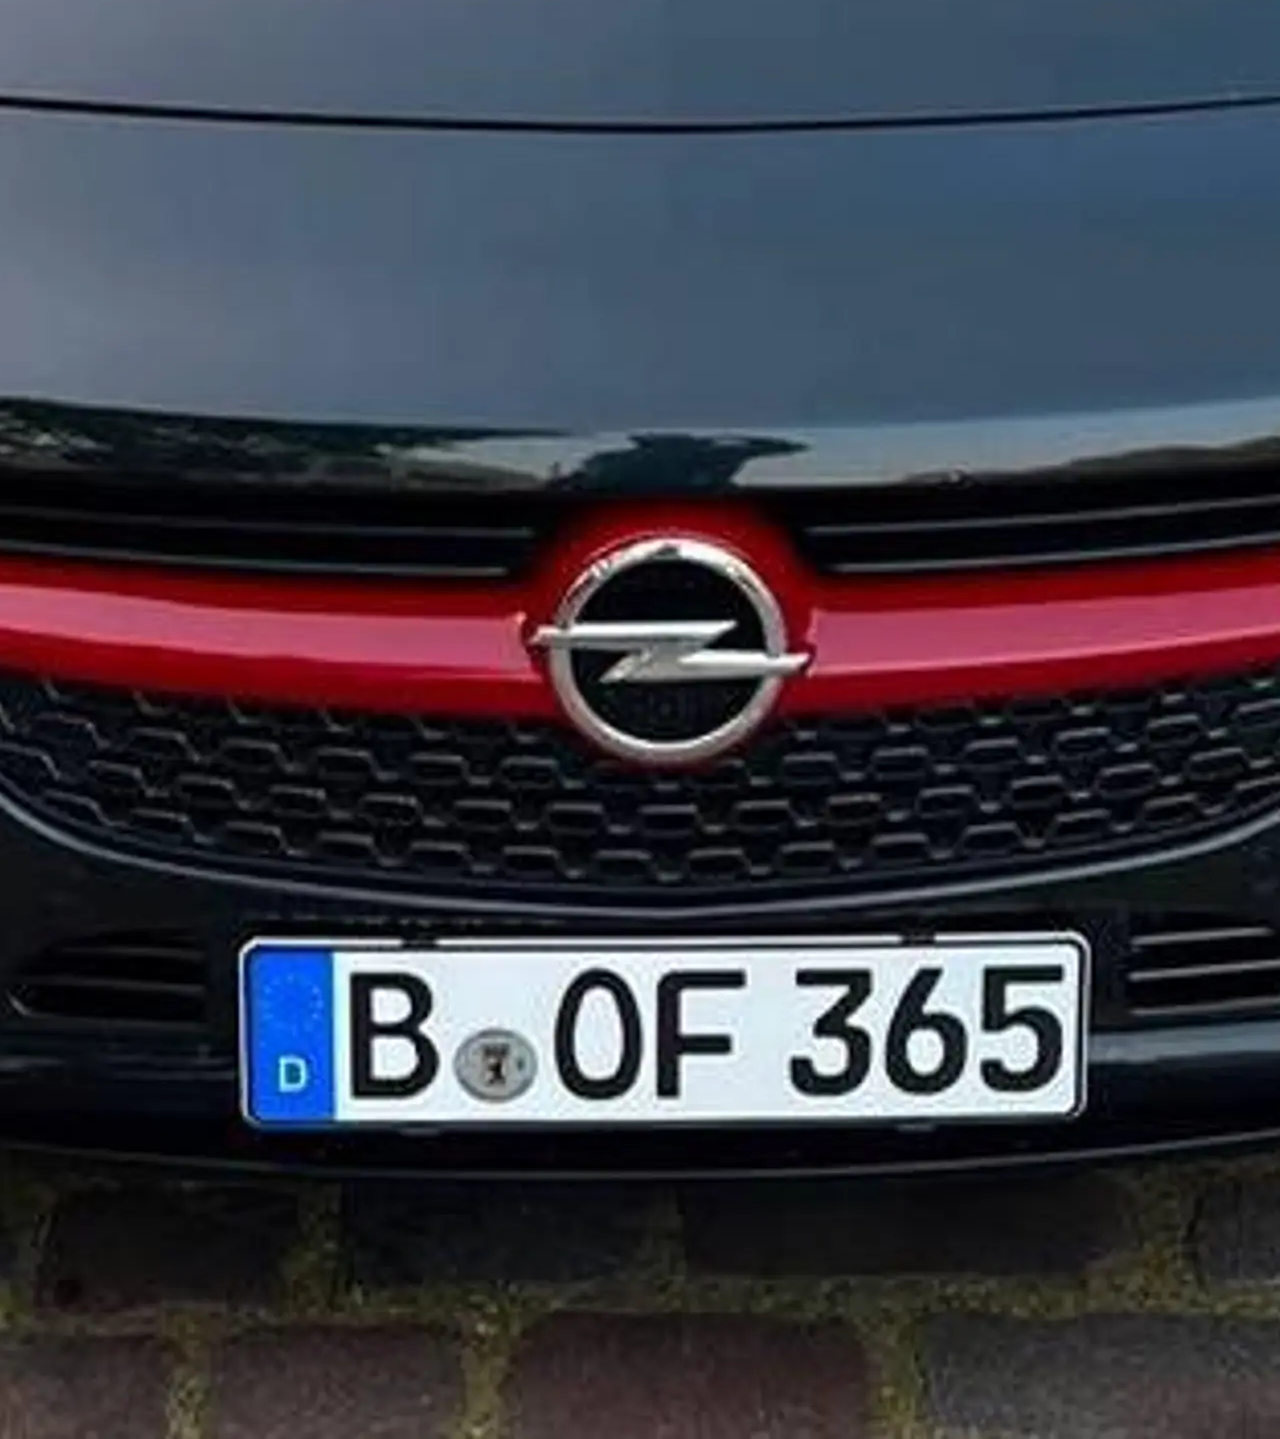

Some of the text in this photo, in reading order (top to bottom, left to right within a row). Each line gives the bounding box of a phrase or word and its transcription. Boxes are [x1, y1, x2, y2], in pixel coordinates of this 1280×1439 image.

[278, 1055, 307, 1093] D
[348, 963, 1065, 1102] B OF 365
